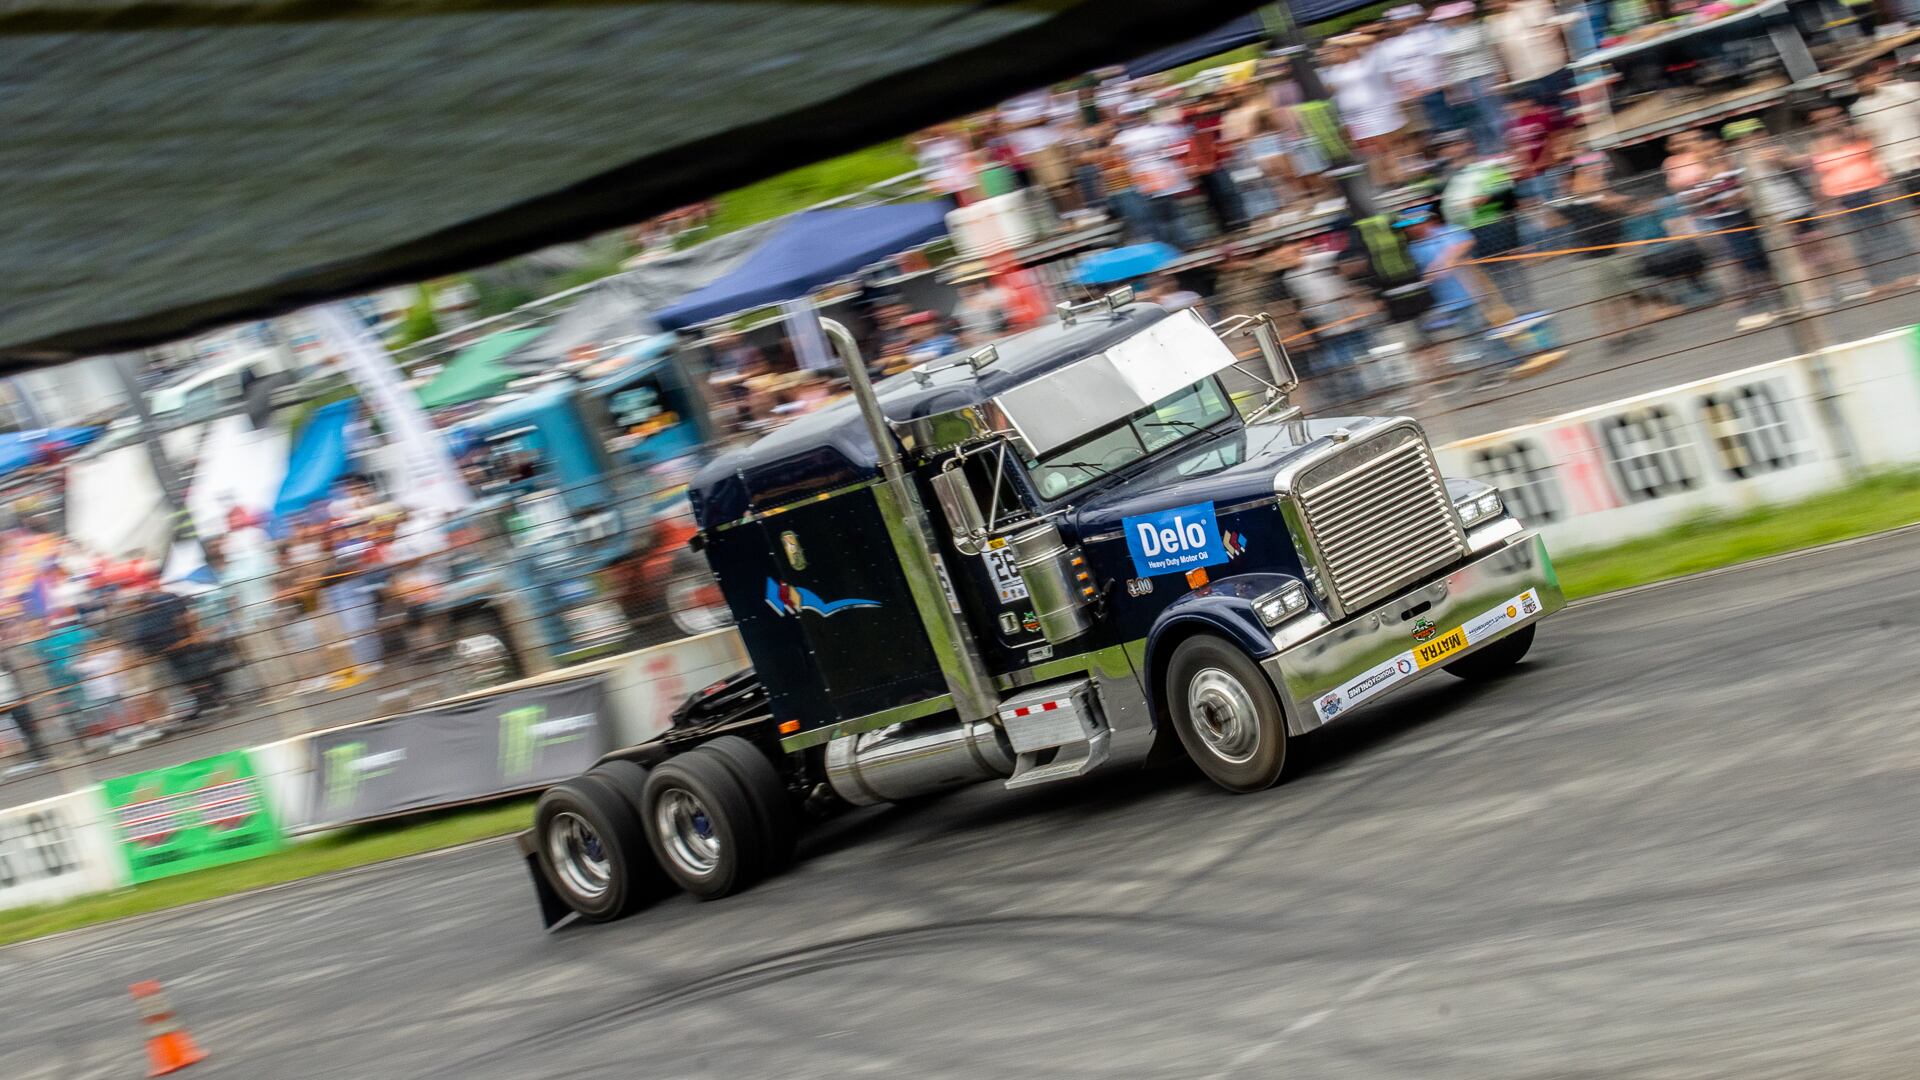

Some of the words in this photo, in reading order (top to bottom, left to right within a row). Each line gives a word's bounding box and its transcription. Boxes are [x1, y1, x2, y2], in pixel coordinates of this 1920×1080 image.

[1137, 516, 1207, 557] Delo
[990, 550, 1020, 581] 26
[1148, 560, 1167, 569] Heavy
[1166, 558, 1180, 567] Duty
[1180, 555, 1198, 564] Motor
[1198, 551, 1209, 560] Oil
[1420, 632, 1462, 661] MATRA
